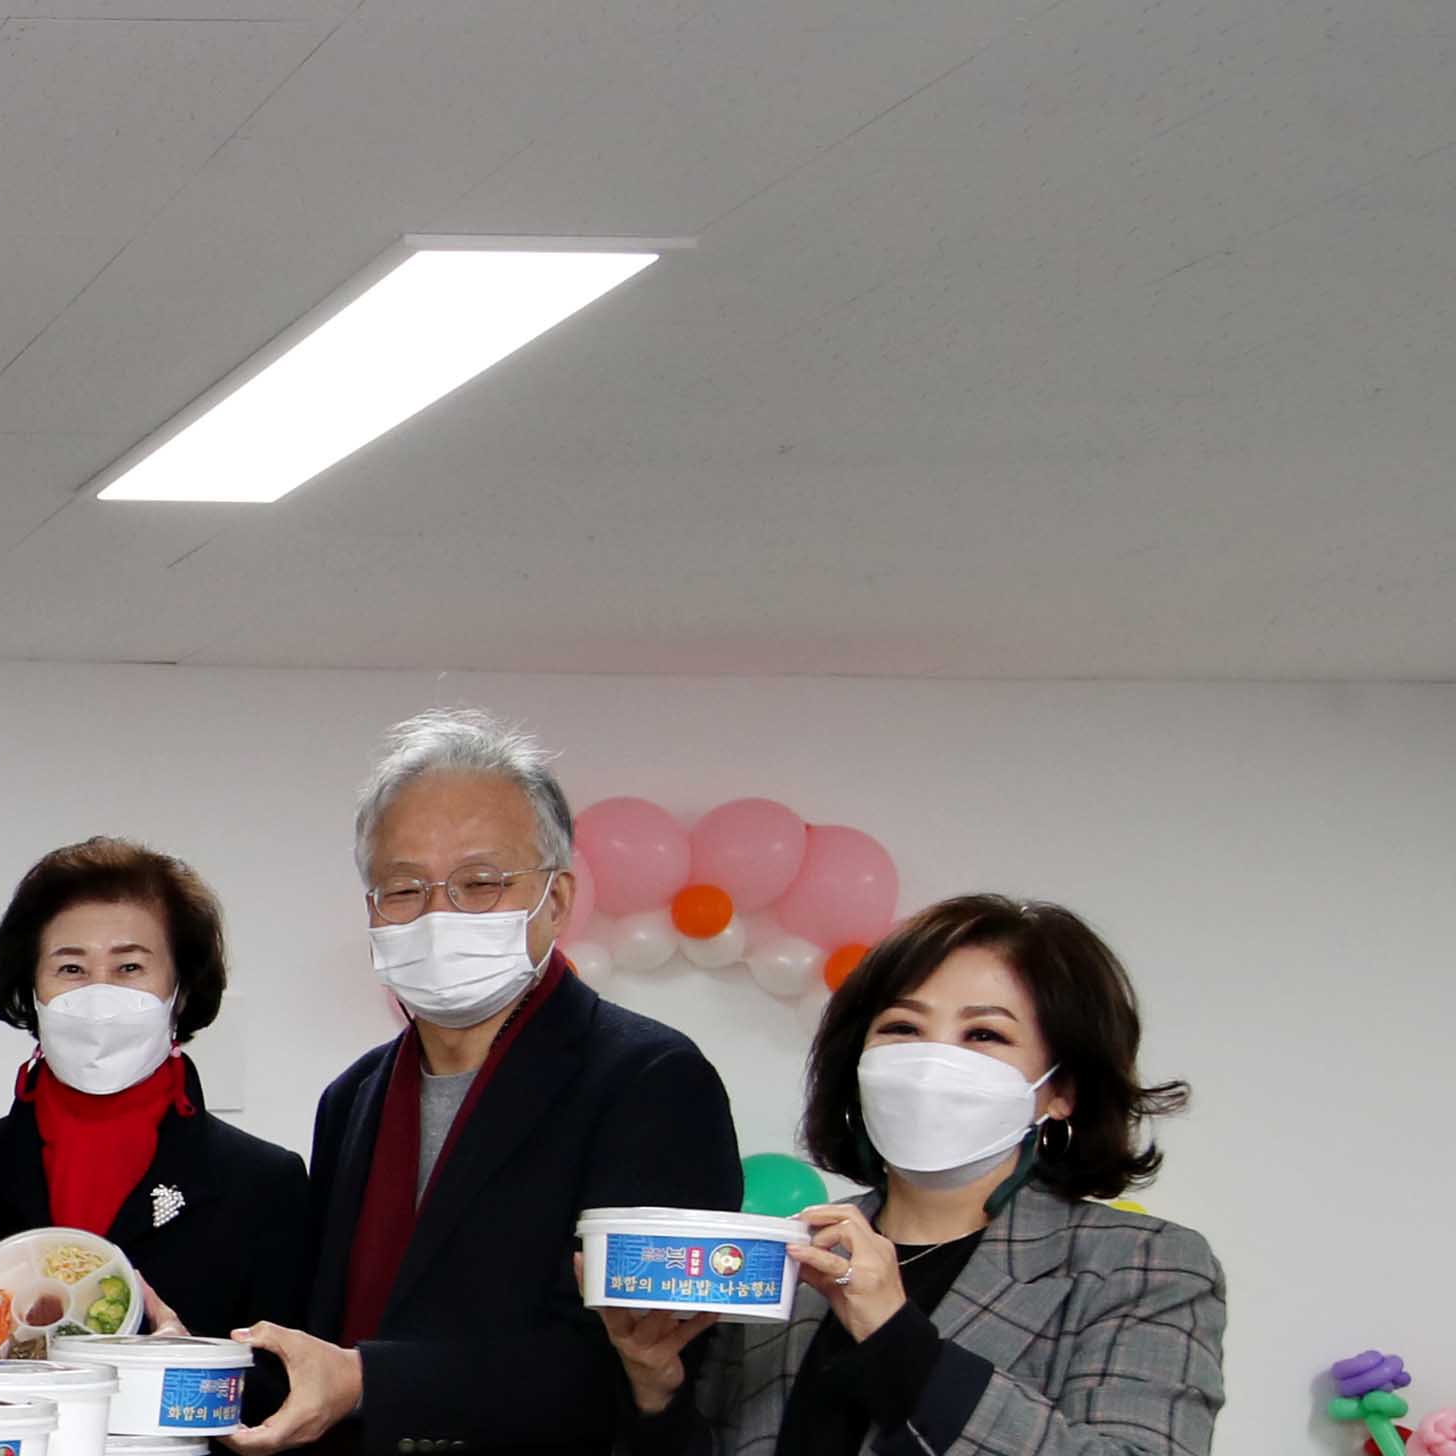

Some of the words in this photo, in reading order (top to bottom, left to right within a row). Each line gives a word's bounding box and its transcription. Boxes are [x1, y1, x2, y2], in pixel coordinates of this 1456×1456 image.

[611, 1277, 652, 1292] 화합의
[662, 1280, 712, 1297] 비빔밥
[720, 1280, 776, 1297] 나눔행사
[168, 1406, 207, 1421] 화합의
